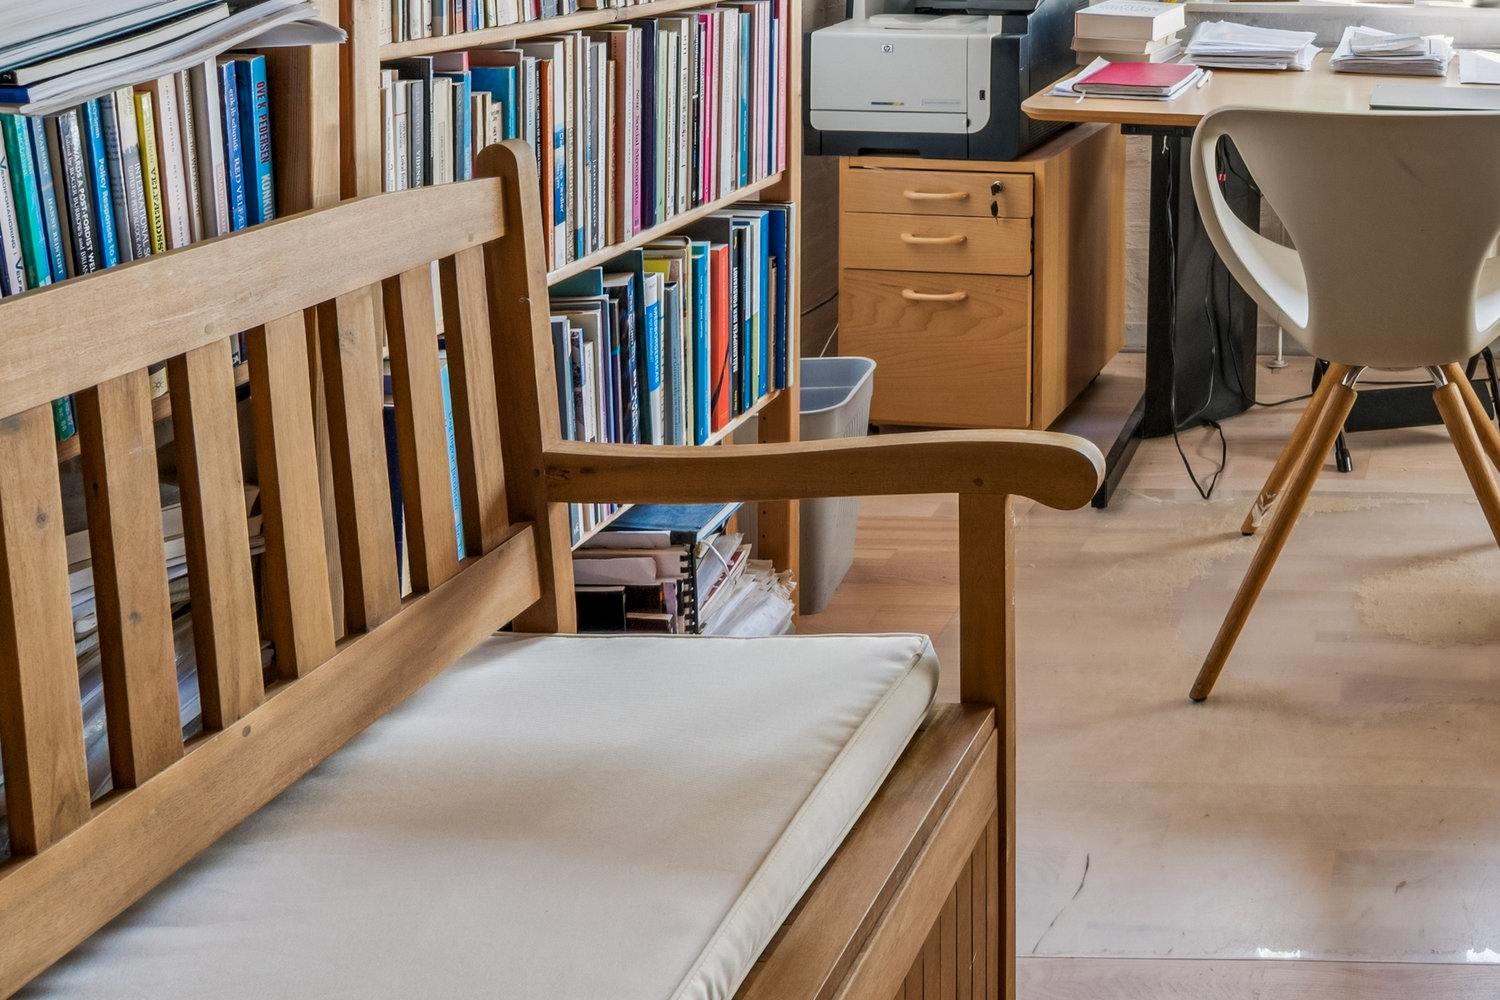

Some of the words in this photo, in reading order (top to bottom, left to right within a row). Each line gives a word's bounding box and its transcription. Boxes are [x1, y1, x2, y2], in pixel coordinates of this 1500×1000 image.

[256, 81, 266, 101] OVE
[258, 114, 270, 164] PEDERSEN
[98, 158, 107, 188] Policy
[101, 191, 112, 244] Responses
[107, 246, 115, 256] to
